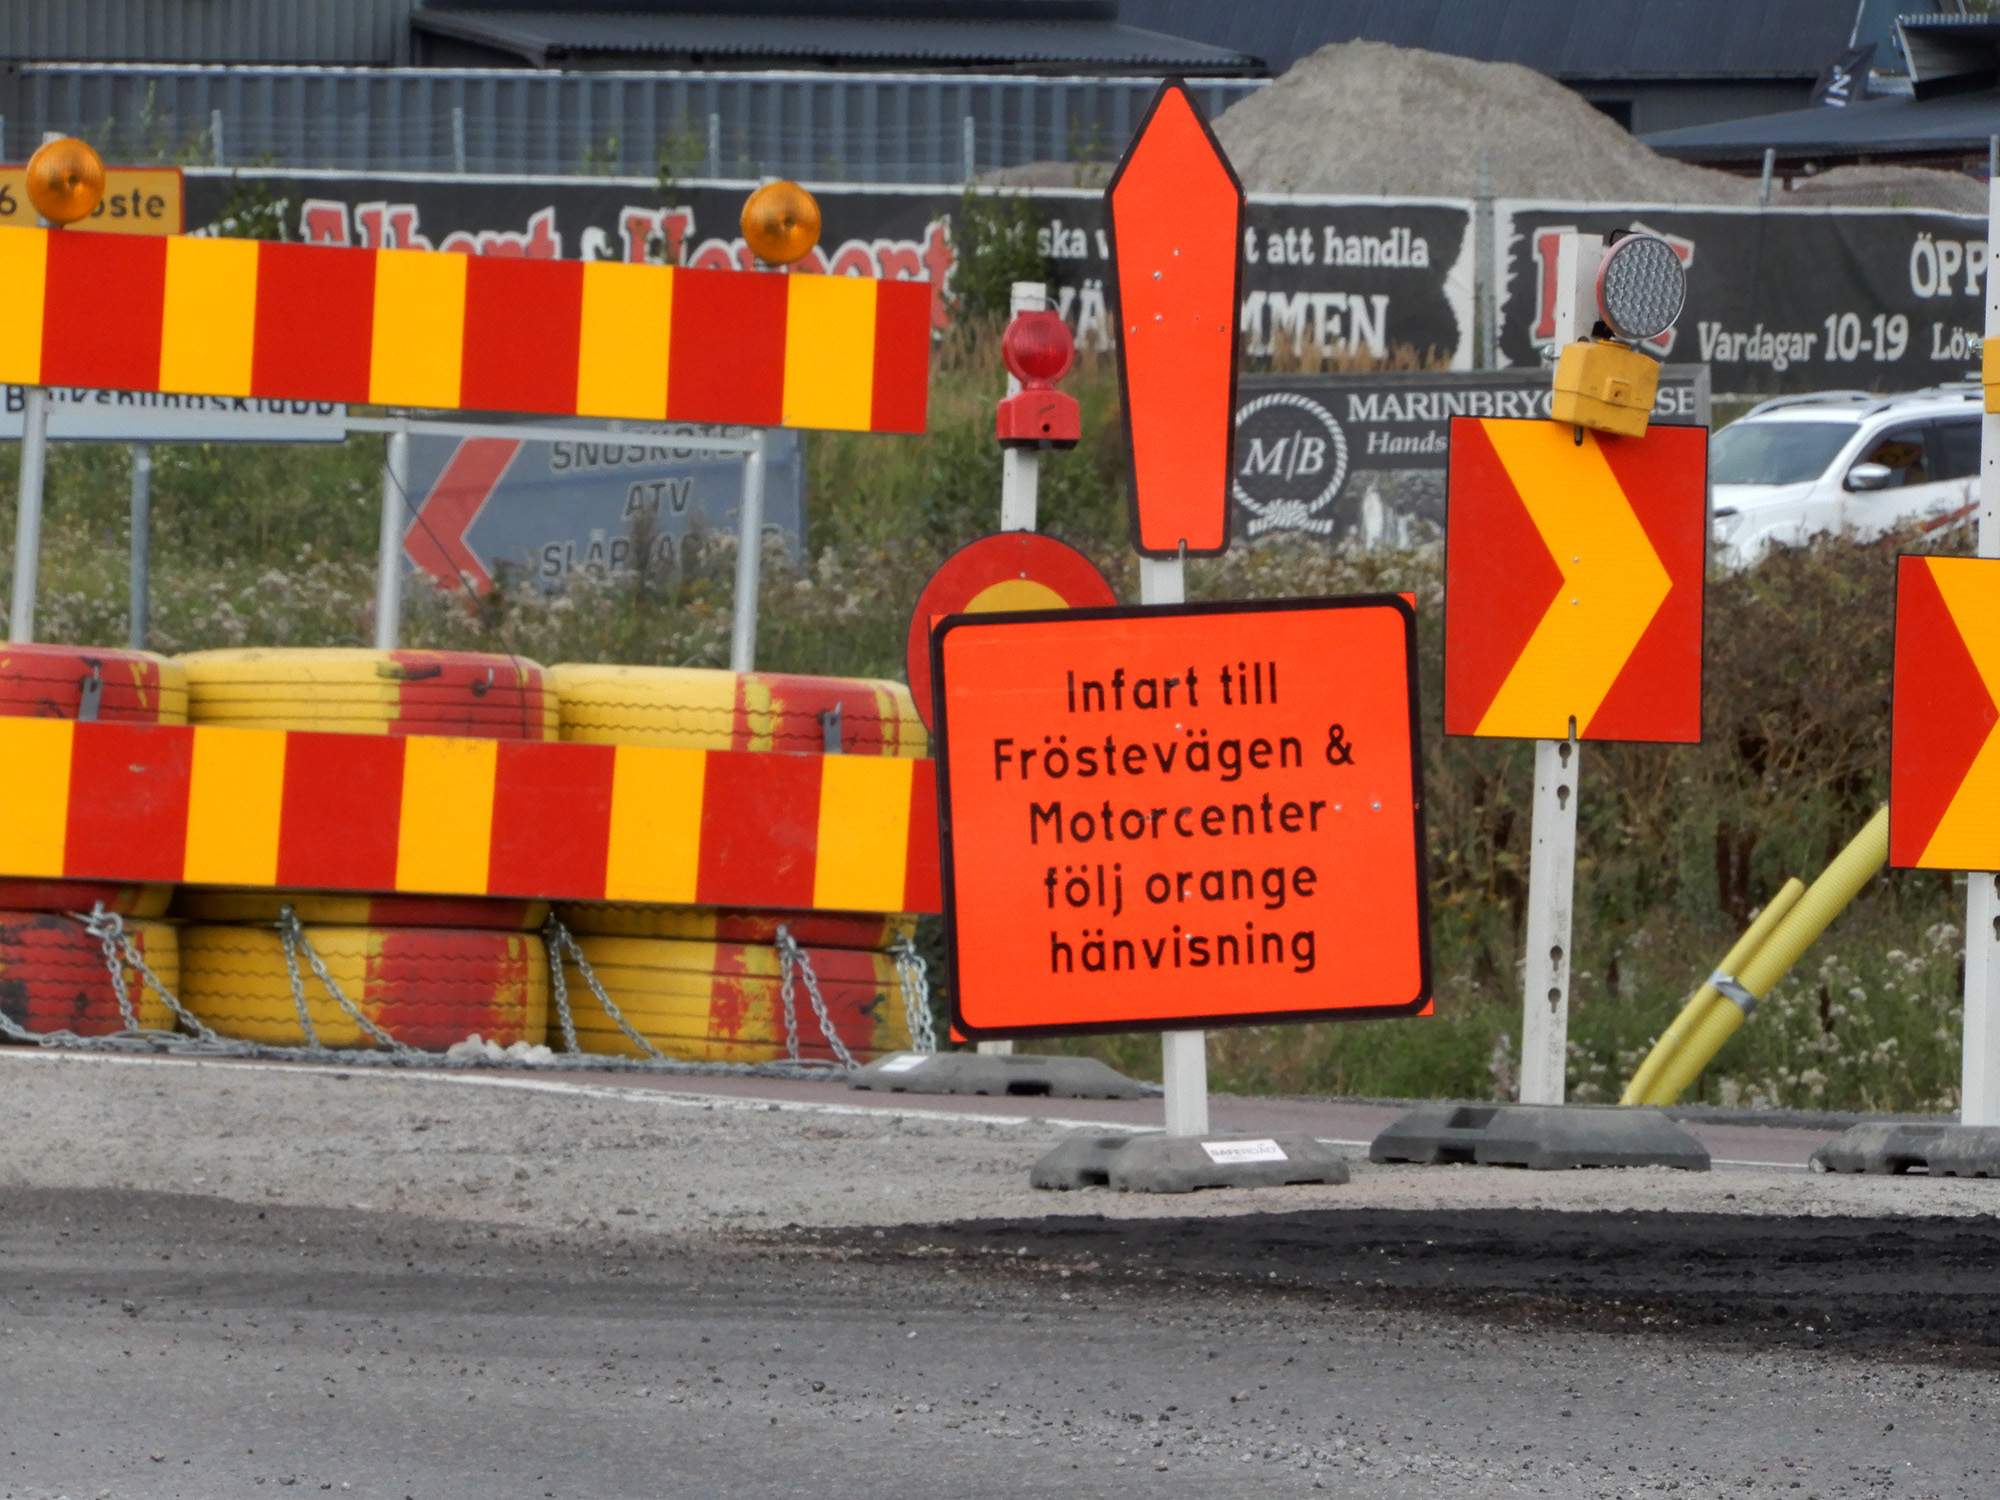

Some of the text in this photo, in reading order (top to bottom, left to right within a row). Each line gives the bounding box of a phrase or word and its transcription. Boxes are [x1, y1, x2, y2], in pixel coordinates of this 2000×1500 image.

[1036, 219, 1089, 259] ska
[1267, 226, 1315, 265] att
[1323, 225, 1430, 268] handla
[1910, 231, 1988, 298] ÖPP
[1697, 321, 1818, 371] Vardagar
[1824, 312, 1910, 362] 10-19
[1366, 430, 1448, 455] Hands
[624, 478, 692, 518] ATV
[1066, 661, 1279, 713] Infart till
[993, 723, 1356, 782] Fröstevägen &
[1029, 793, 1328, 845] Motorcenter
[1043, 862, 1318, 918] följ orange
[1050, 921, 1317, 974] hänvisning
